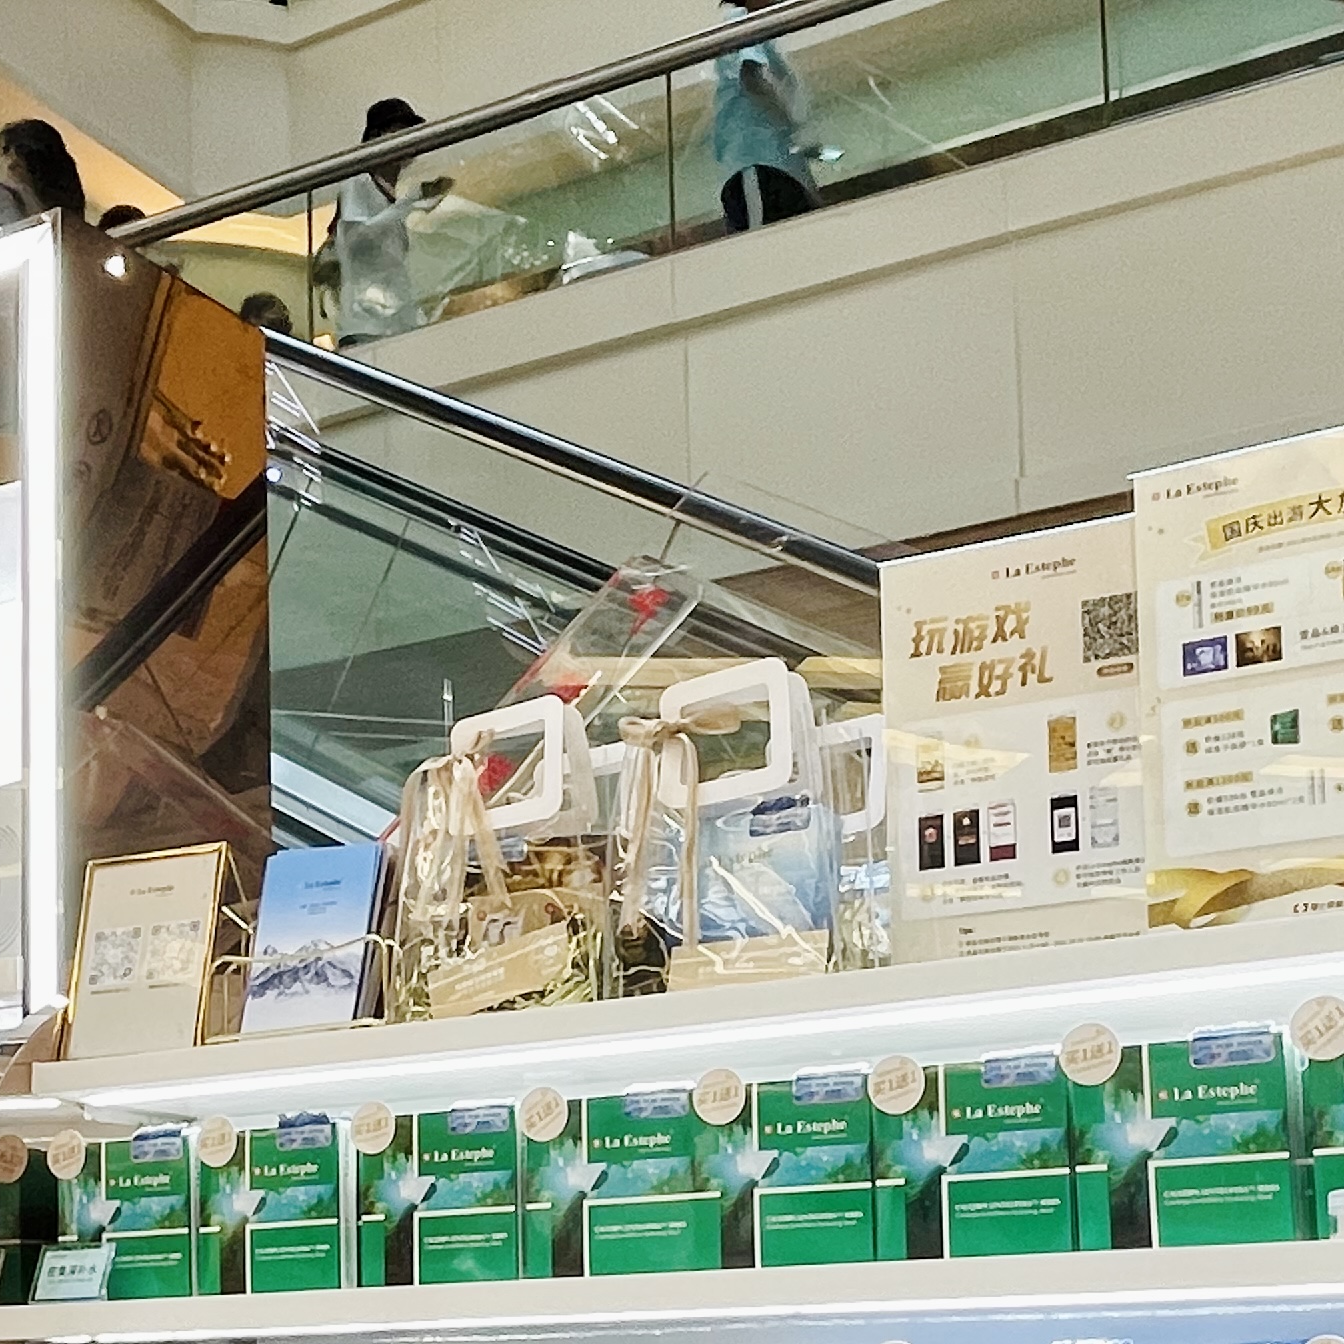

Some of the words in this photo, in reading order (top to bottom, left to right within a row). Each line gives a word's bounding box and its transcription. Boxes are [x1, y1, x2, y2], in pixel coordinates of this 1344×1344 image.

[909, 601, 1031, 659] 玩游戏
[935, 646, 1054, 702] 赢好礼
[1172, 1087, 1192, 1101] La
[1198, 1082, 1258, 1101] Estephe
[965, 1106, 983, 1120] La
[986, 1102, 1043, 1120] Estephe
[776, 1121, 794, 1135] La
[796, 1118, 848, 1136] Estephe
